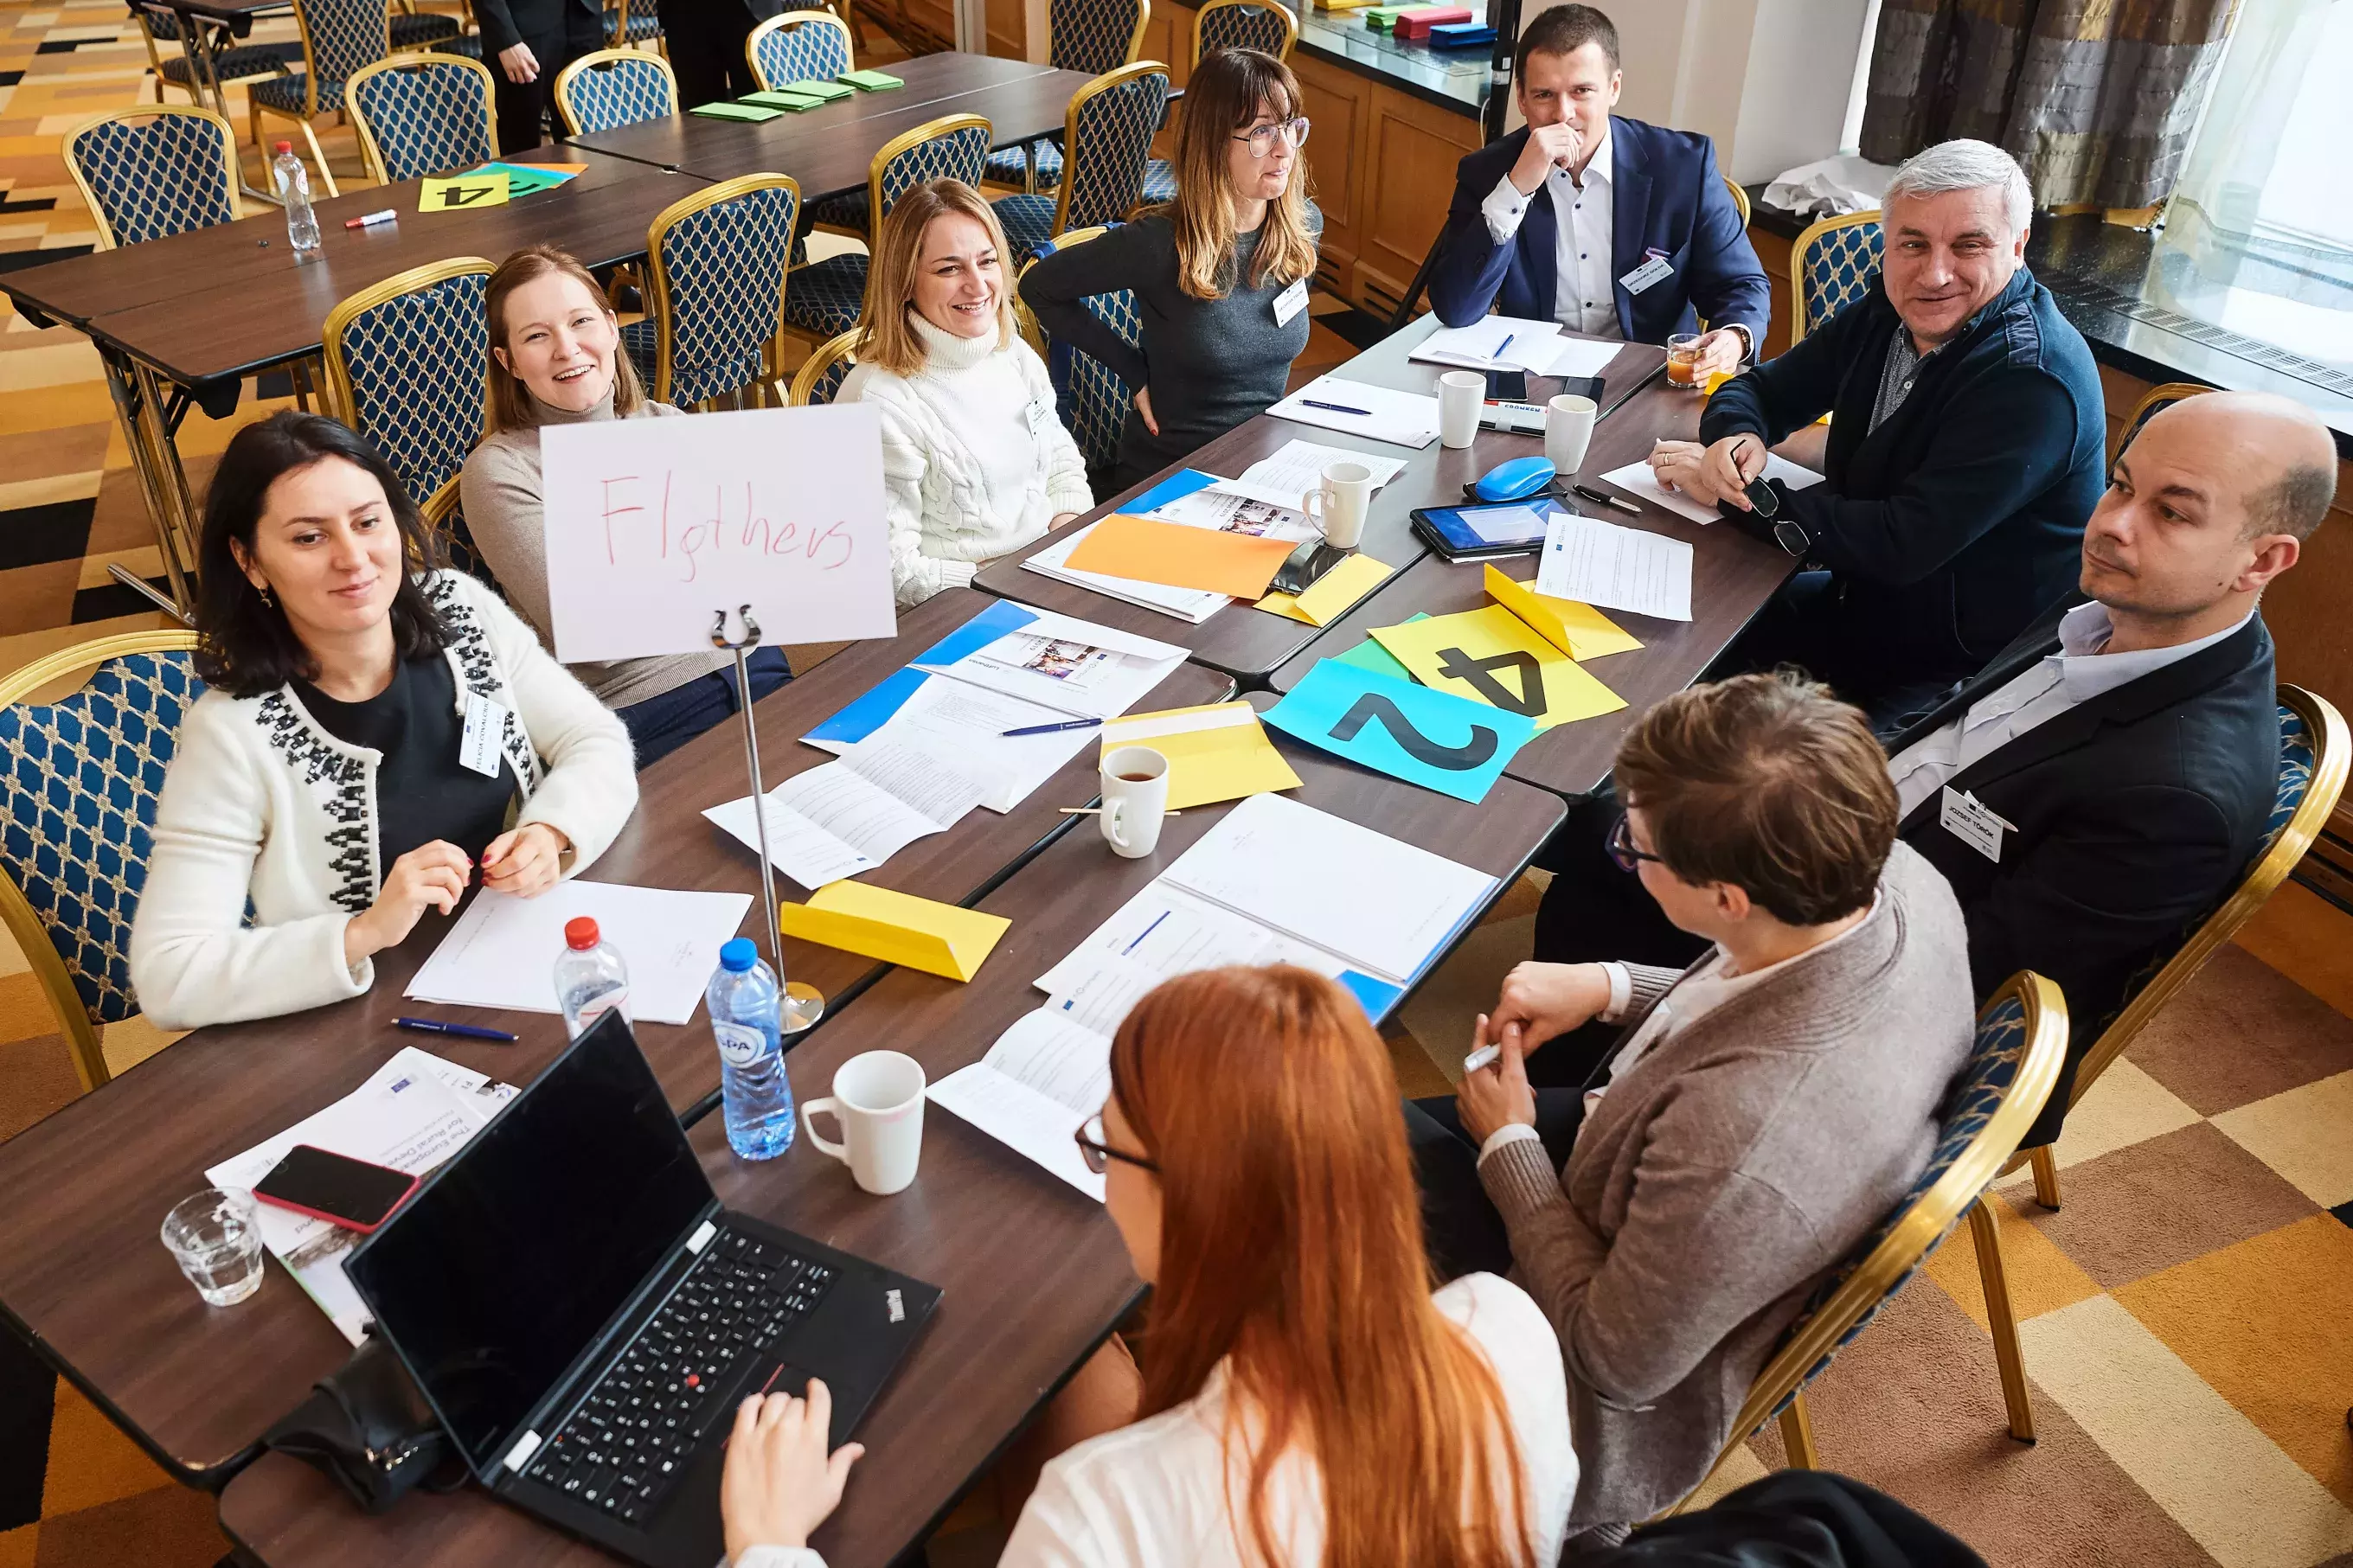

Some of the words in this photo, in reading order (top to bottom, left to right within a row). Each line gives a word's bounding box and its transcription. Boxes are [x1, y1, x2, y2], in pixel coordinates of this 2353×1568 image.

[437, 187, 494, 206] 4
[968, 658, 1000, 671] Lufthansa
[1435, 647, 1548, 717] 4
[1327, 692, 1498, 771] 2
[450, 1124, 471, 1140] The
